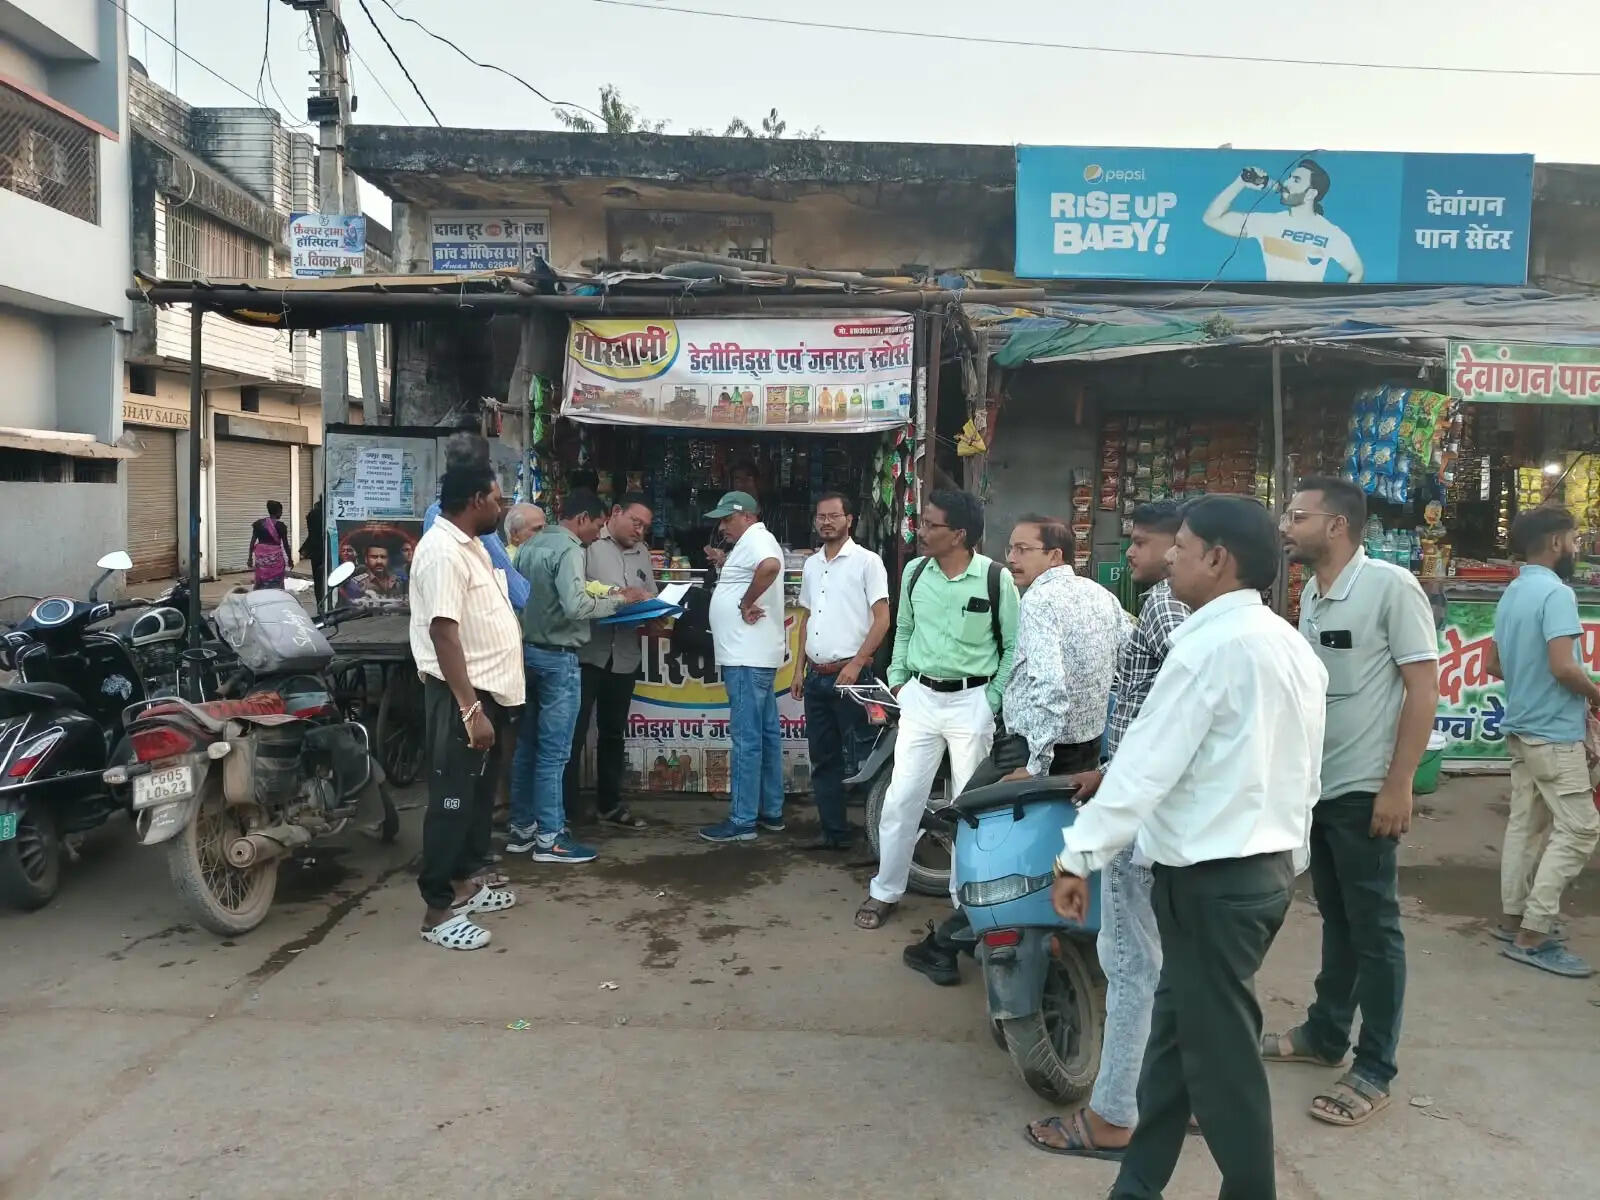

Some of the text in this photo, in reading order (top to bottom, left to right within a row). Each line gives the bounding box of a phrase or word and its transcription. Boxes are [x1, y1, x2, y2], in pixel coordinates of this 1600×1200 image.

[1105, 168, 1146, 183] pepsi
[1134, 191, 1178, 218] UP
[1426, 189, 1506, 216] देवांगन
[296, 233, 338, 247] हॉस्पिटल
[434, 223, 463, 236] दादा
[465, 223, 483, 240] टूर
[1053, 218, 1170, 255] BABY!
[1280, 228, 1329, 249] PEPSI
[1415, 223, 1514, 250] पान सेंटर
[293, 252, 306, 267] डॉ.
[308, 251, 341, 267] विकास
[460, 243, 503, 260] ऑफिस
[775, 341, 804, 371] एवं
[806, 348, 866, 371] जनरल
[868, 337, 911, 370] स्टोर्स
[1456, 346, 1553, 396] देवांगन
[156, 410, 188, 425] SALES
[680, 713, 705, 738] एवं
